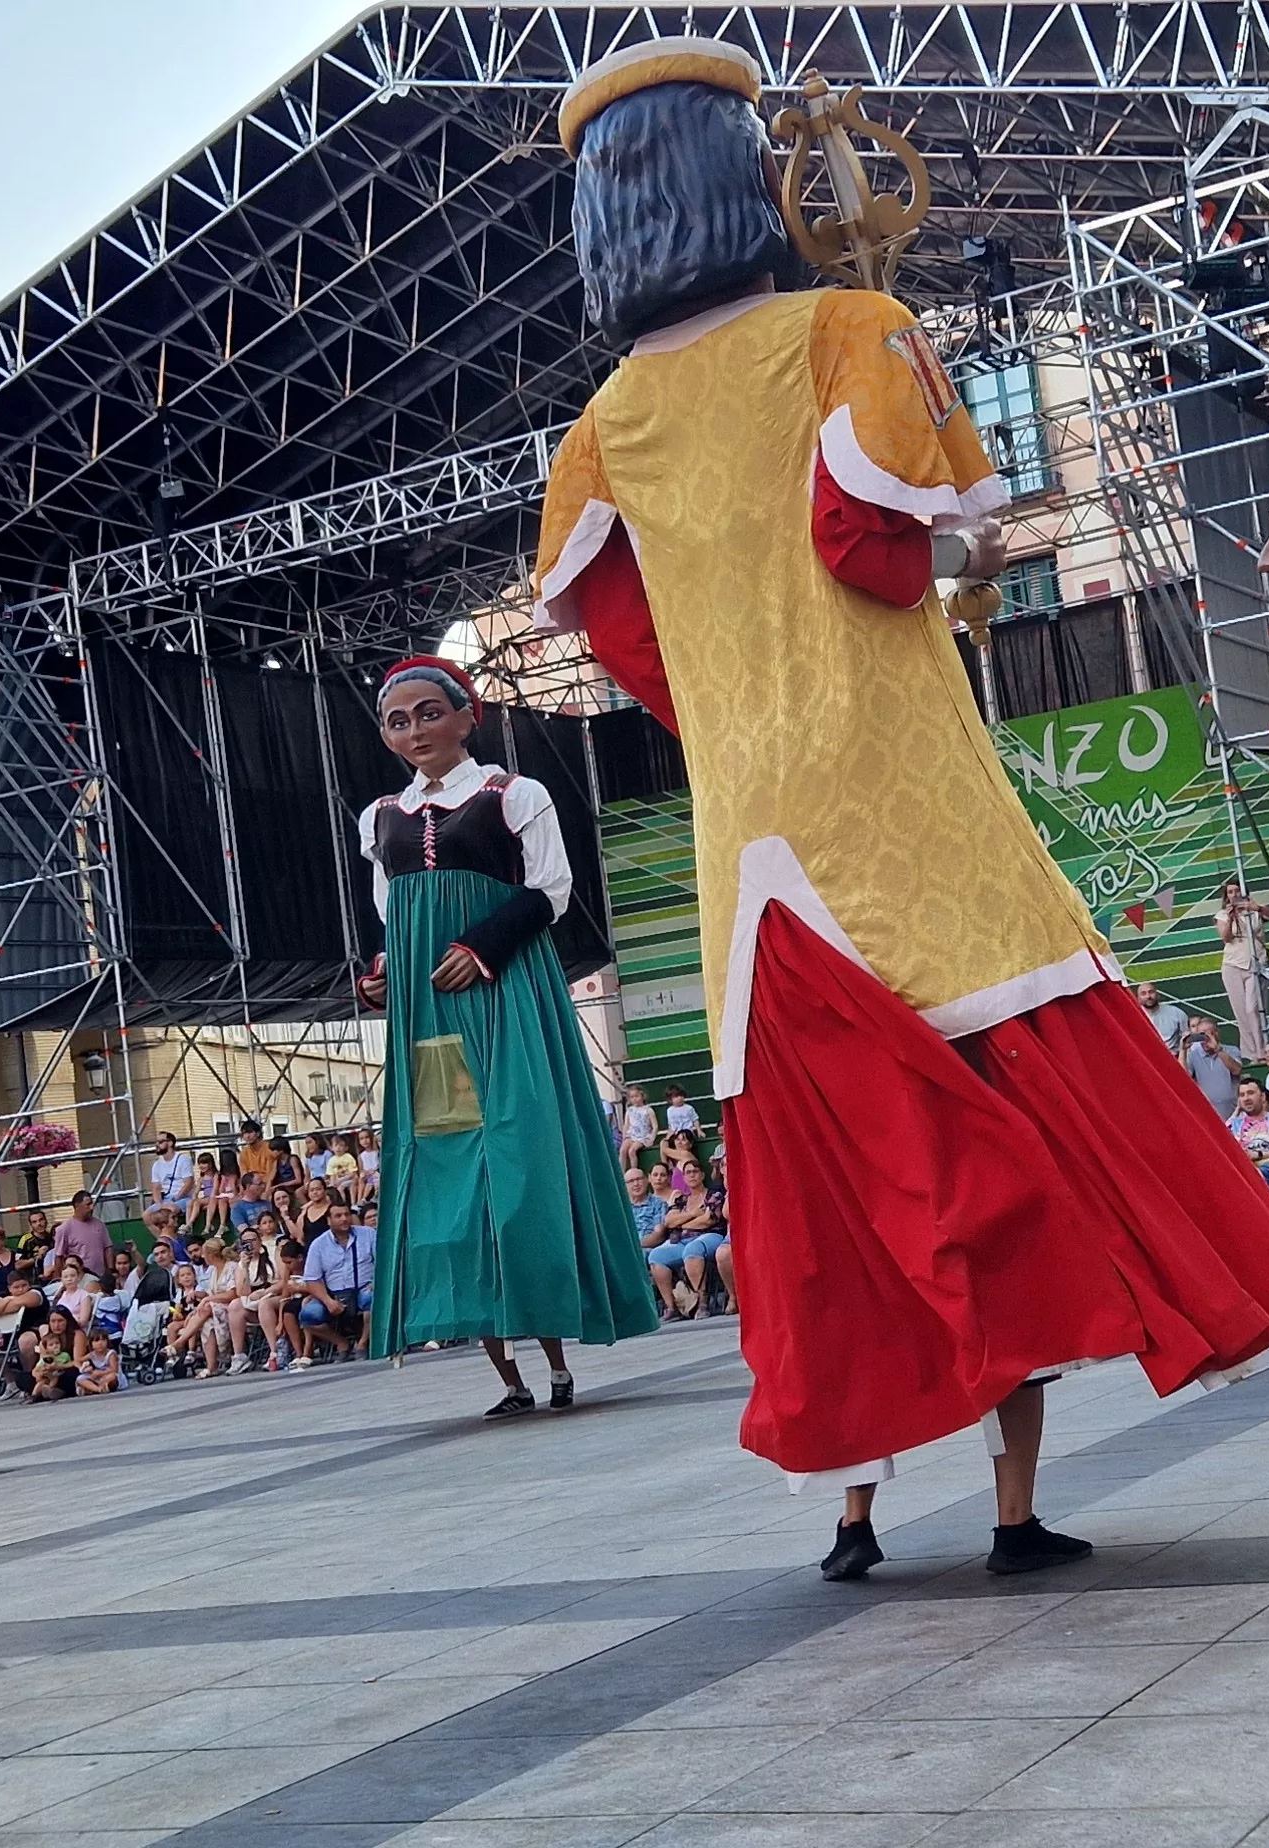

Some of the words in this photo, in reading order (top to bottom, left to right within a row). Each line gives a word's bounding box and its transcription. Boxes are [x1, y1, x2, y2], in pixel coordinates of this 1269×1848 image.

[1018, 704, 1169, 796] NZO
[1079, 786, 1197, 837] más
[1076, 847, 1160, 909] vas
